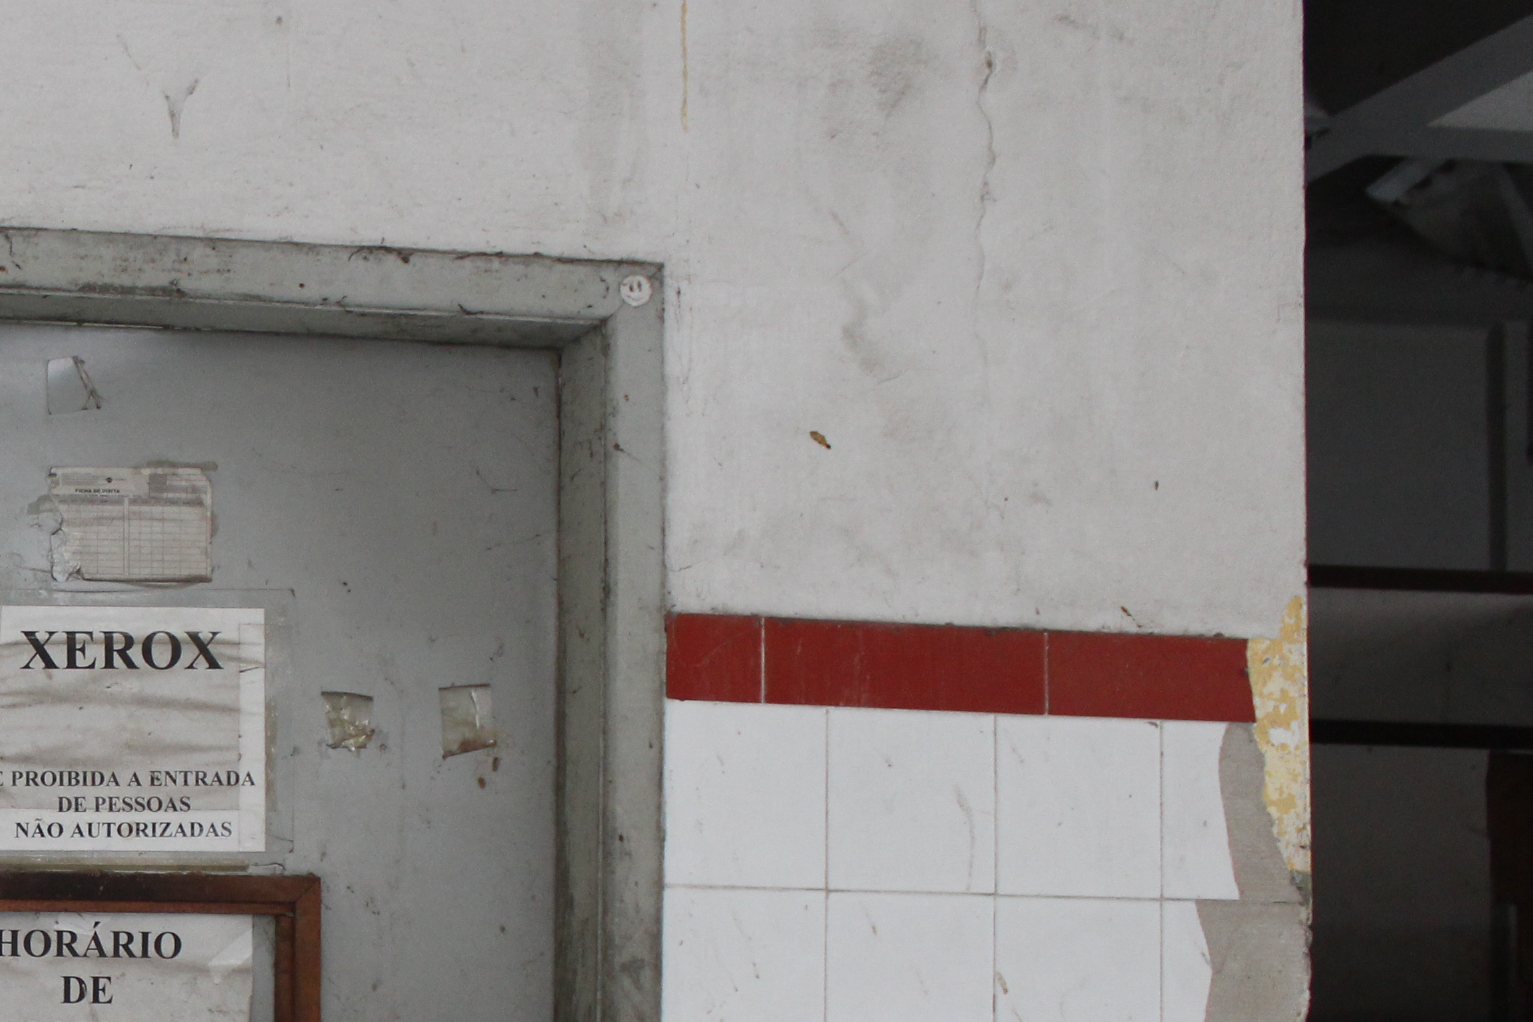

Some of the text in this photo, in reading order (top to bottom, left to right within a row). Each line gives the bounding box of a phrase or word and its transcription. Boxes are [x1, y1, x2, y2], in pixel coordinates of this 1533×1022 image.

[20, 630, 224, 670] XEROX
[11, 770, 120, 787] PROIBIDA
[127, 770, 142, 787] A
[149, 770, 256, 787] ENTRADA
[57, 796, 192, 813] DE PESSOAS
[15, 818, 233, 839] NÃO AUTORIZADAS
[61, 976, 114, 1004] DE
